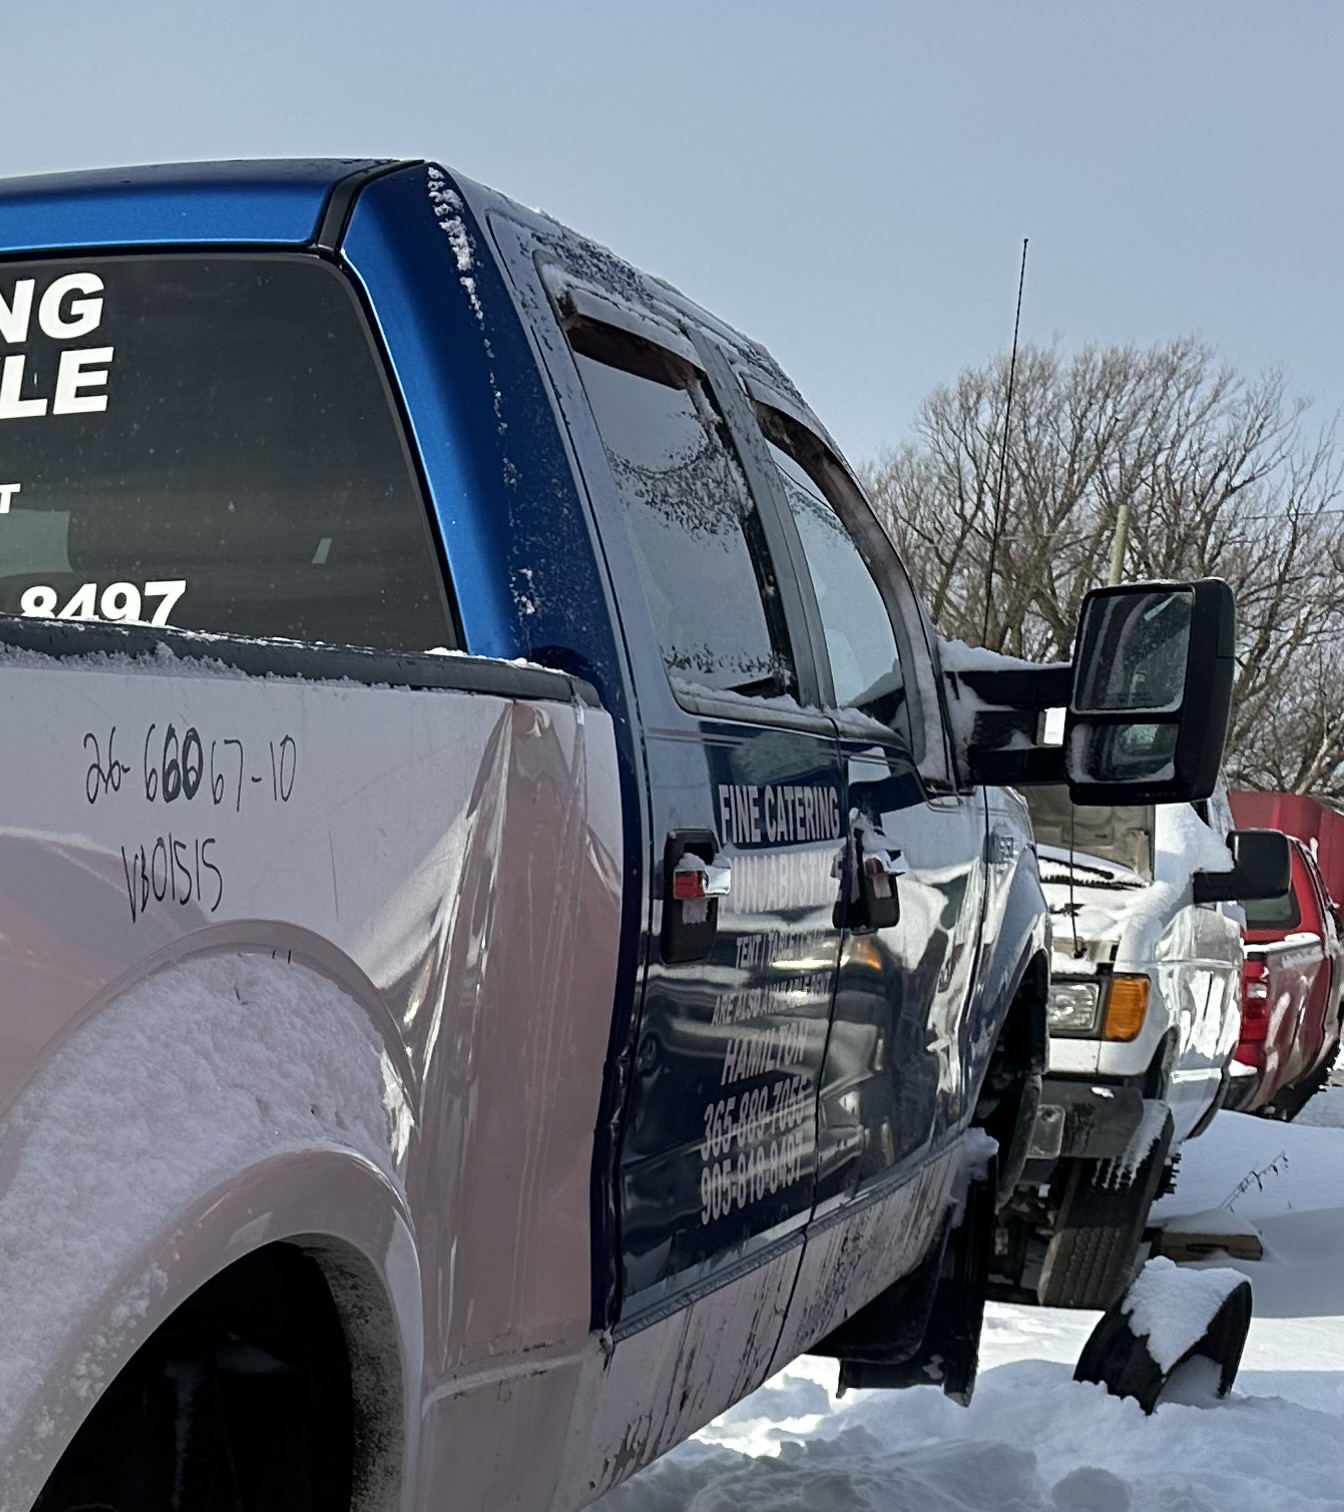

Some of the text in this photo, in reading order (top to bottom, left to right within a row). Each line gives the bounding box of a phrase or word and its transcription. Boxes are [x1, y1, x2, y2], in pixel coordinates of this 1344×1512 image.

[718, 784, 841, 844] FINE CATERING
[719, 852, 795, 916] UNJABI
[736, 934, 762, 969] TENT
[711, 990, 737, 1026] ARE
[722, 1021, 809, 1086] HAMILTON
[700, 1131, 804, 1225] 905-818-8497
